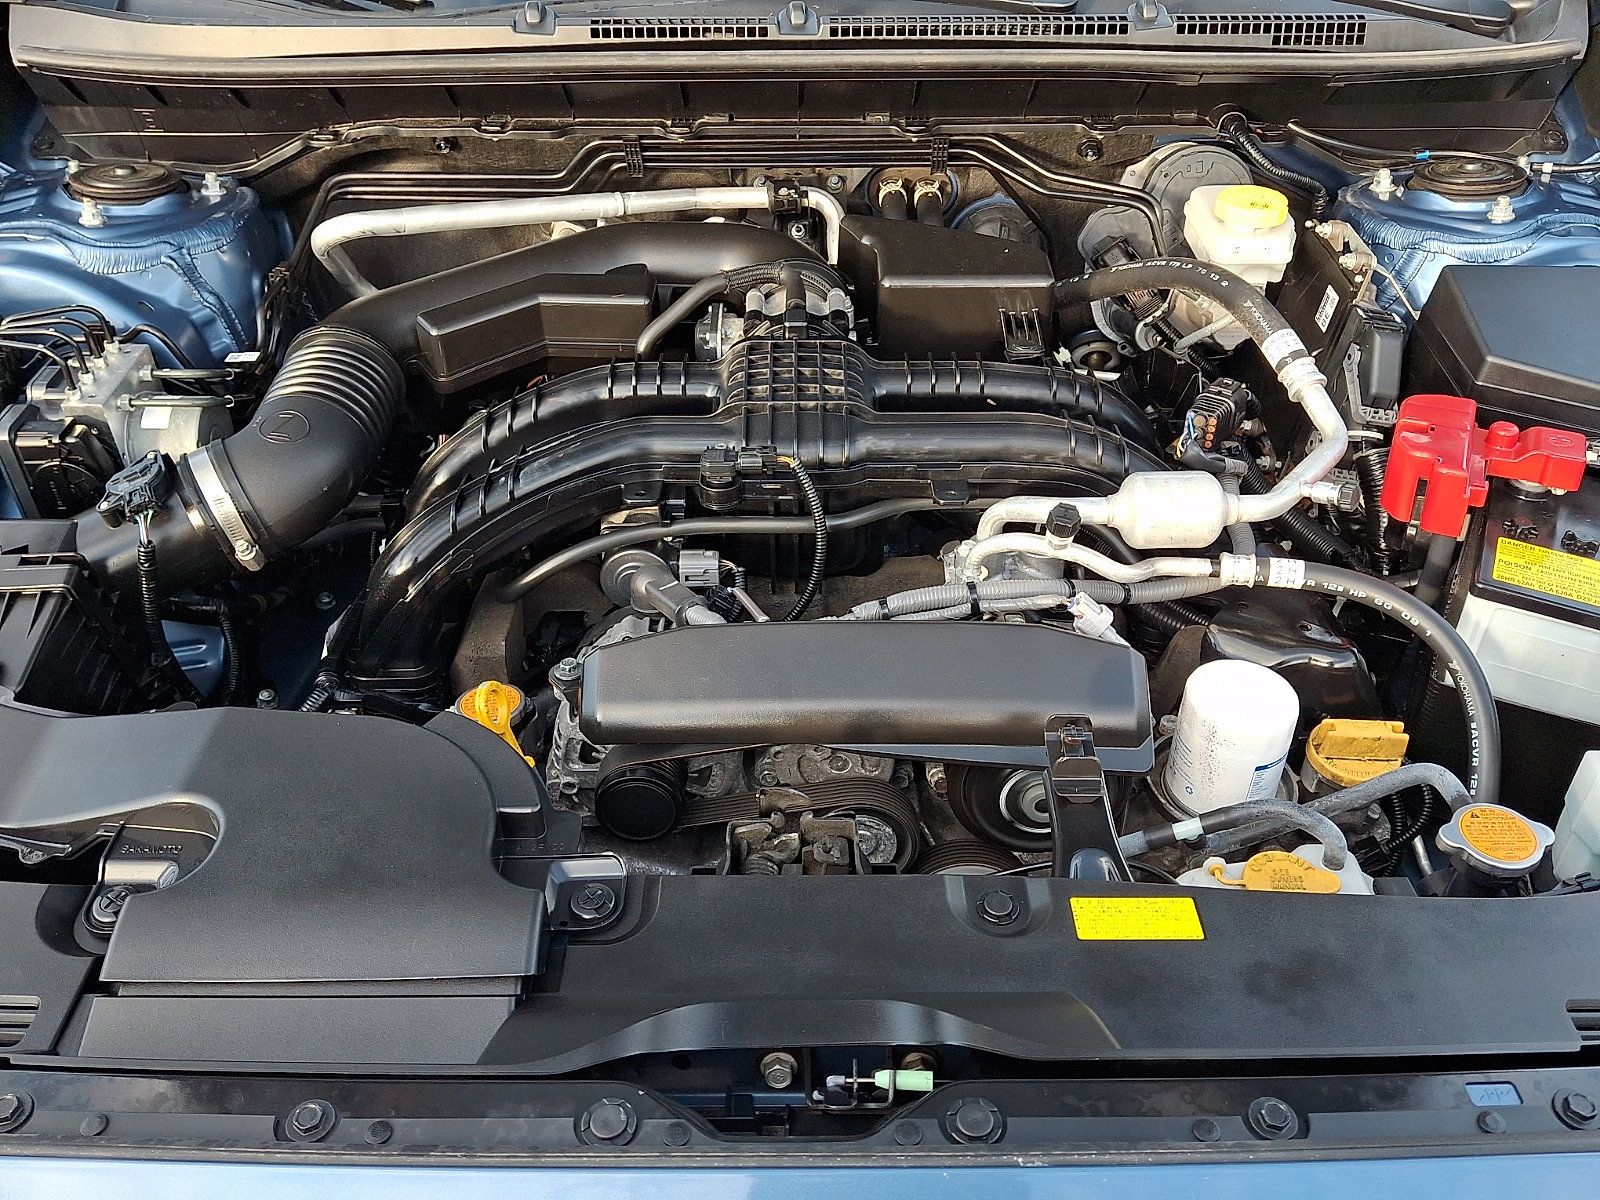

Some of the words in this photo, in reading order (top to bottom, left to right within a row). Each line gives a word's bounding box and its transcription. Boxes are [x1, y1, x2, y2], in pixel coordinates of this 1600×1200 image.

[1501, 539, 1536, 552] DANGER
[1498, 558, 1532, 571] POISON
[1348, 588, 1367, 599] HP
[1538, 584, 1554, 593] CCA
[1454, 671, 1476, 717] YOKOHAMA
[1471, 729, 1479, 767] ACVR
[1248, 852, 1316, 872] COOLANT
